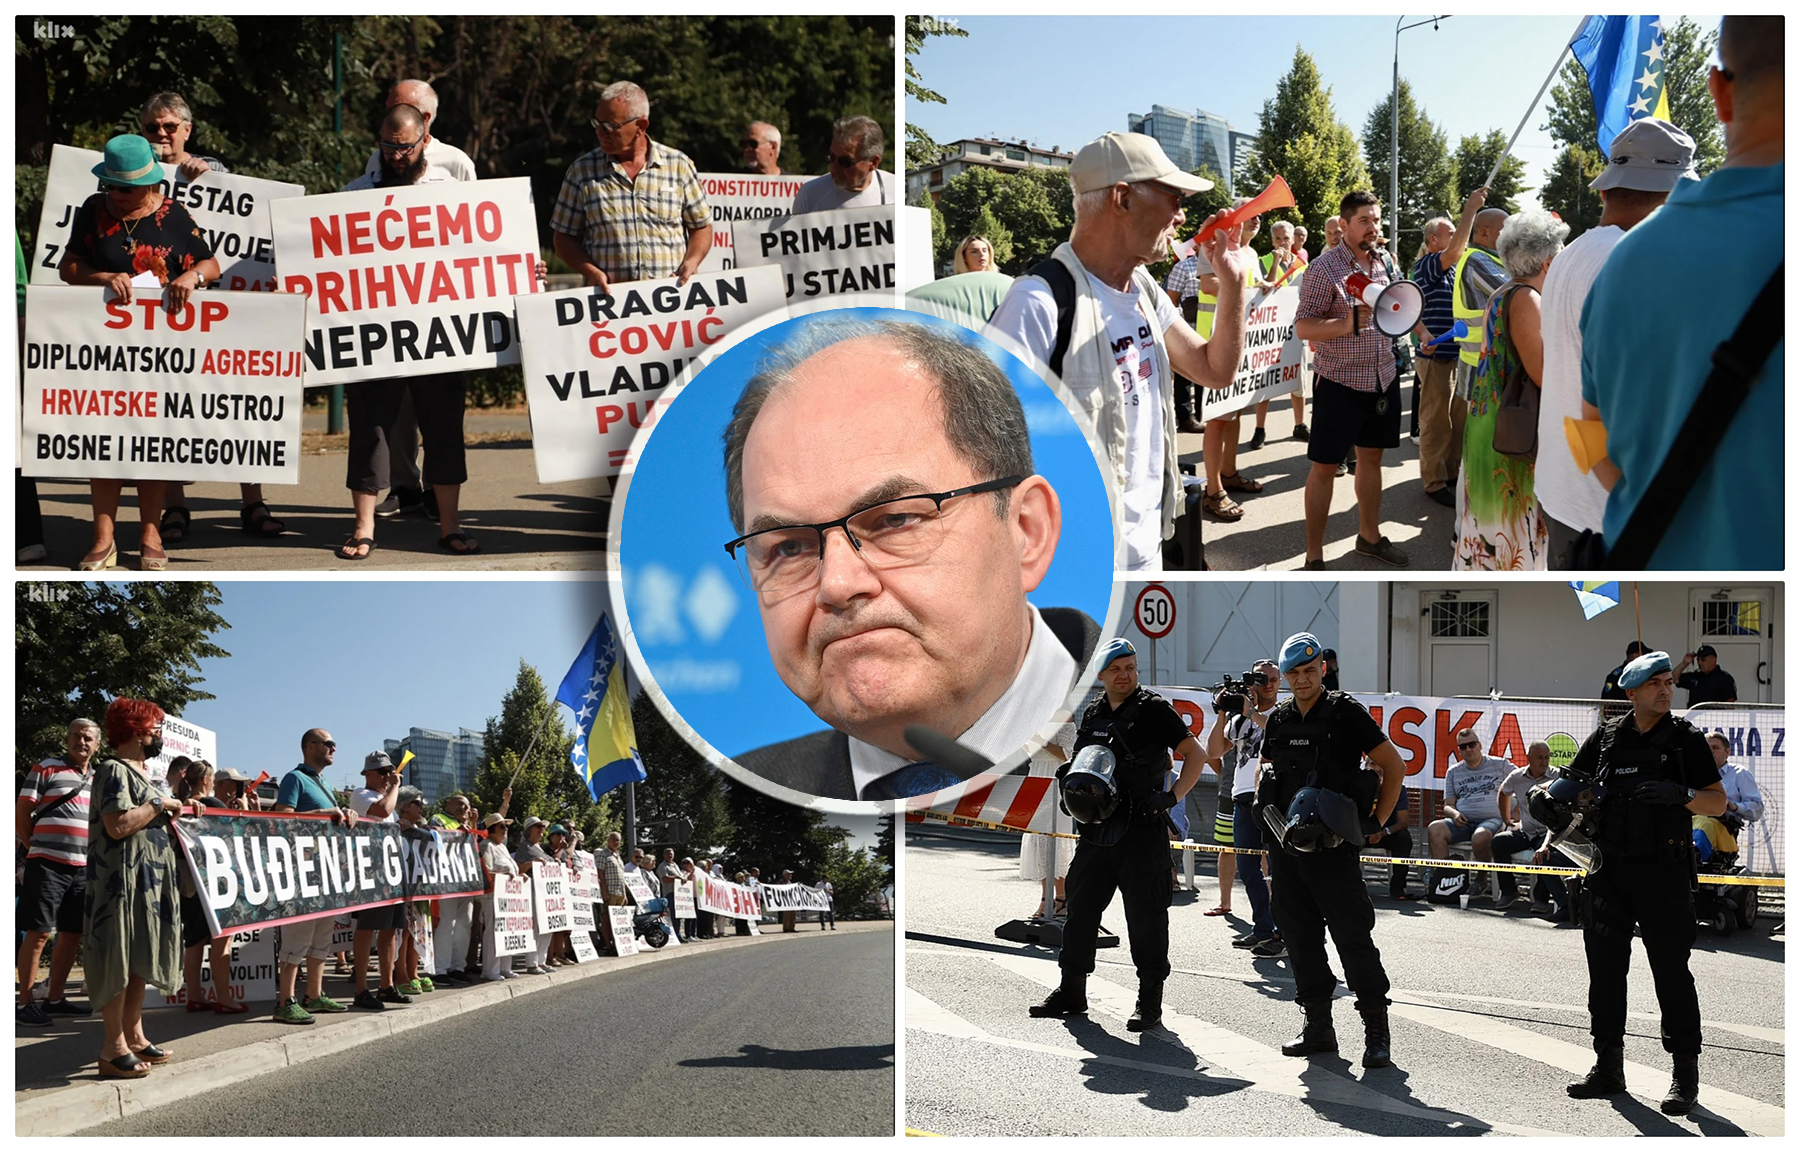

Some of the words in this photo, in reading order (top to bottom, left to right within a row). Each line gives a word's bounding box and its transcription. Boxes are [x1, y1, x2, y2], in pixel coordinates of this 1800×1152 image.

[310, 195, 503, 258] NEĆEMO
[760, 220, 895, 257] PRIMJEN
[284, 253, 538, 314] PRIHVATITI
[104, 298, 229, 332] STOP
[555, 277, 748, 326] DRAGAN
[304, 310, 520, 372] NEPRAVD
[589, 308, 726, 359] ČOVIĆ
[1277, 325, 1294, 342] VAS
[27, 343, 196, 375] DIPLOMATSKOJ
[201, 348, 301, 378] AGRESIJI
[1252, 347, 1283, 370] OPREZ
[1232, 377, 1247, 397] NE
[1248, 368, 1281, 392] ŽELITE
[1282, 363, 1300, 382] RAT
[41, 388, 158, 418] HRVATSKE
[164, 392, 195, 419] NA
[201, 394, 284, 422] USTROJ
[36, 434, 111, 461] BOSNE
[118, 435, 124, 462] I
[131, 436, 286, 467] HERCEGOVINE
[1144, 599, 1168, 625] 50
[162, 720, 200, 742] PRESUDA
[192, 747, 202, 758] JE
[1615, 767, 1638, 775] POLICIJA
[199, 834, 375, 910] BUĐENJE
[546, 882, 561, 895] OPET
[545, 898, 566, 912] IZDAJE
[547, 914, 568, 930] BOSNU
